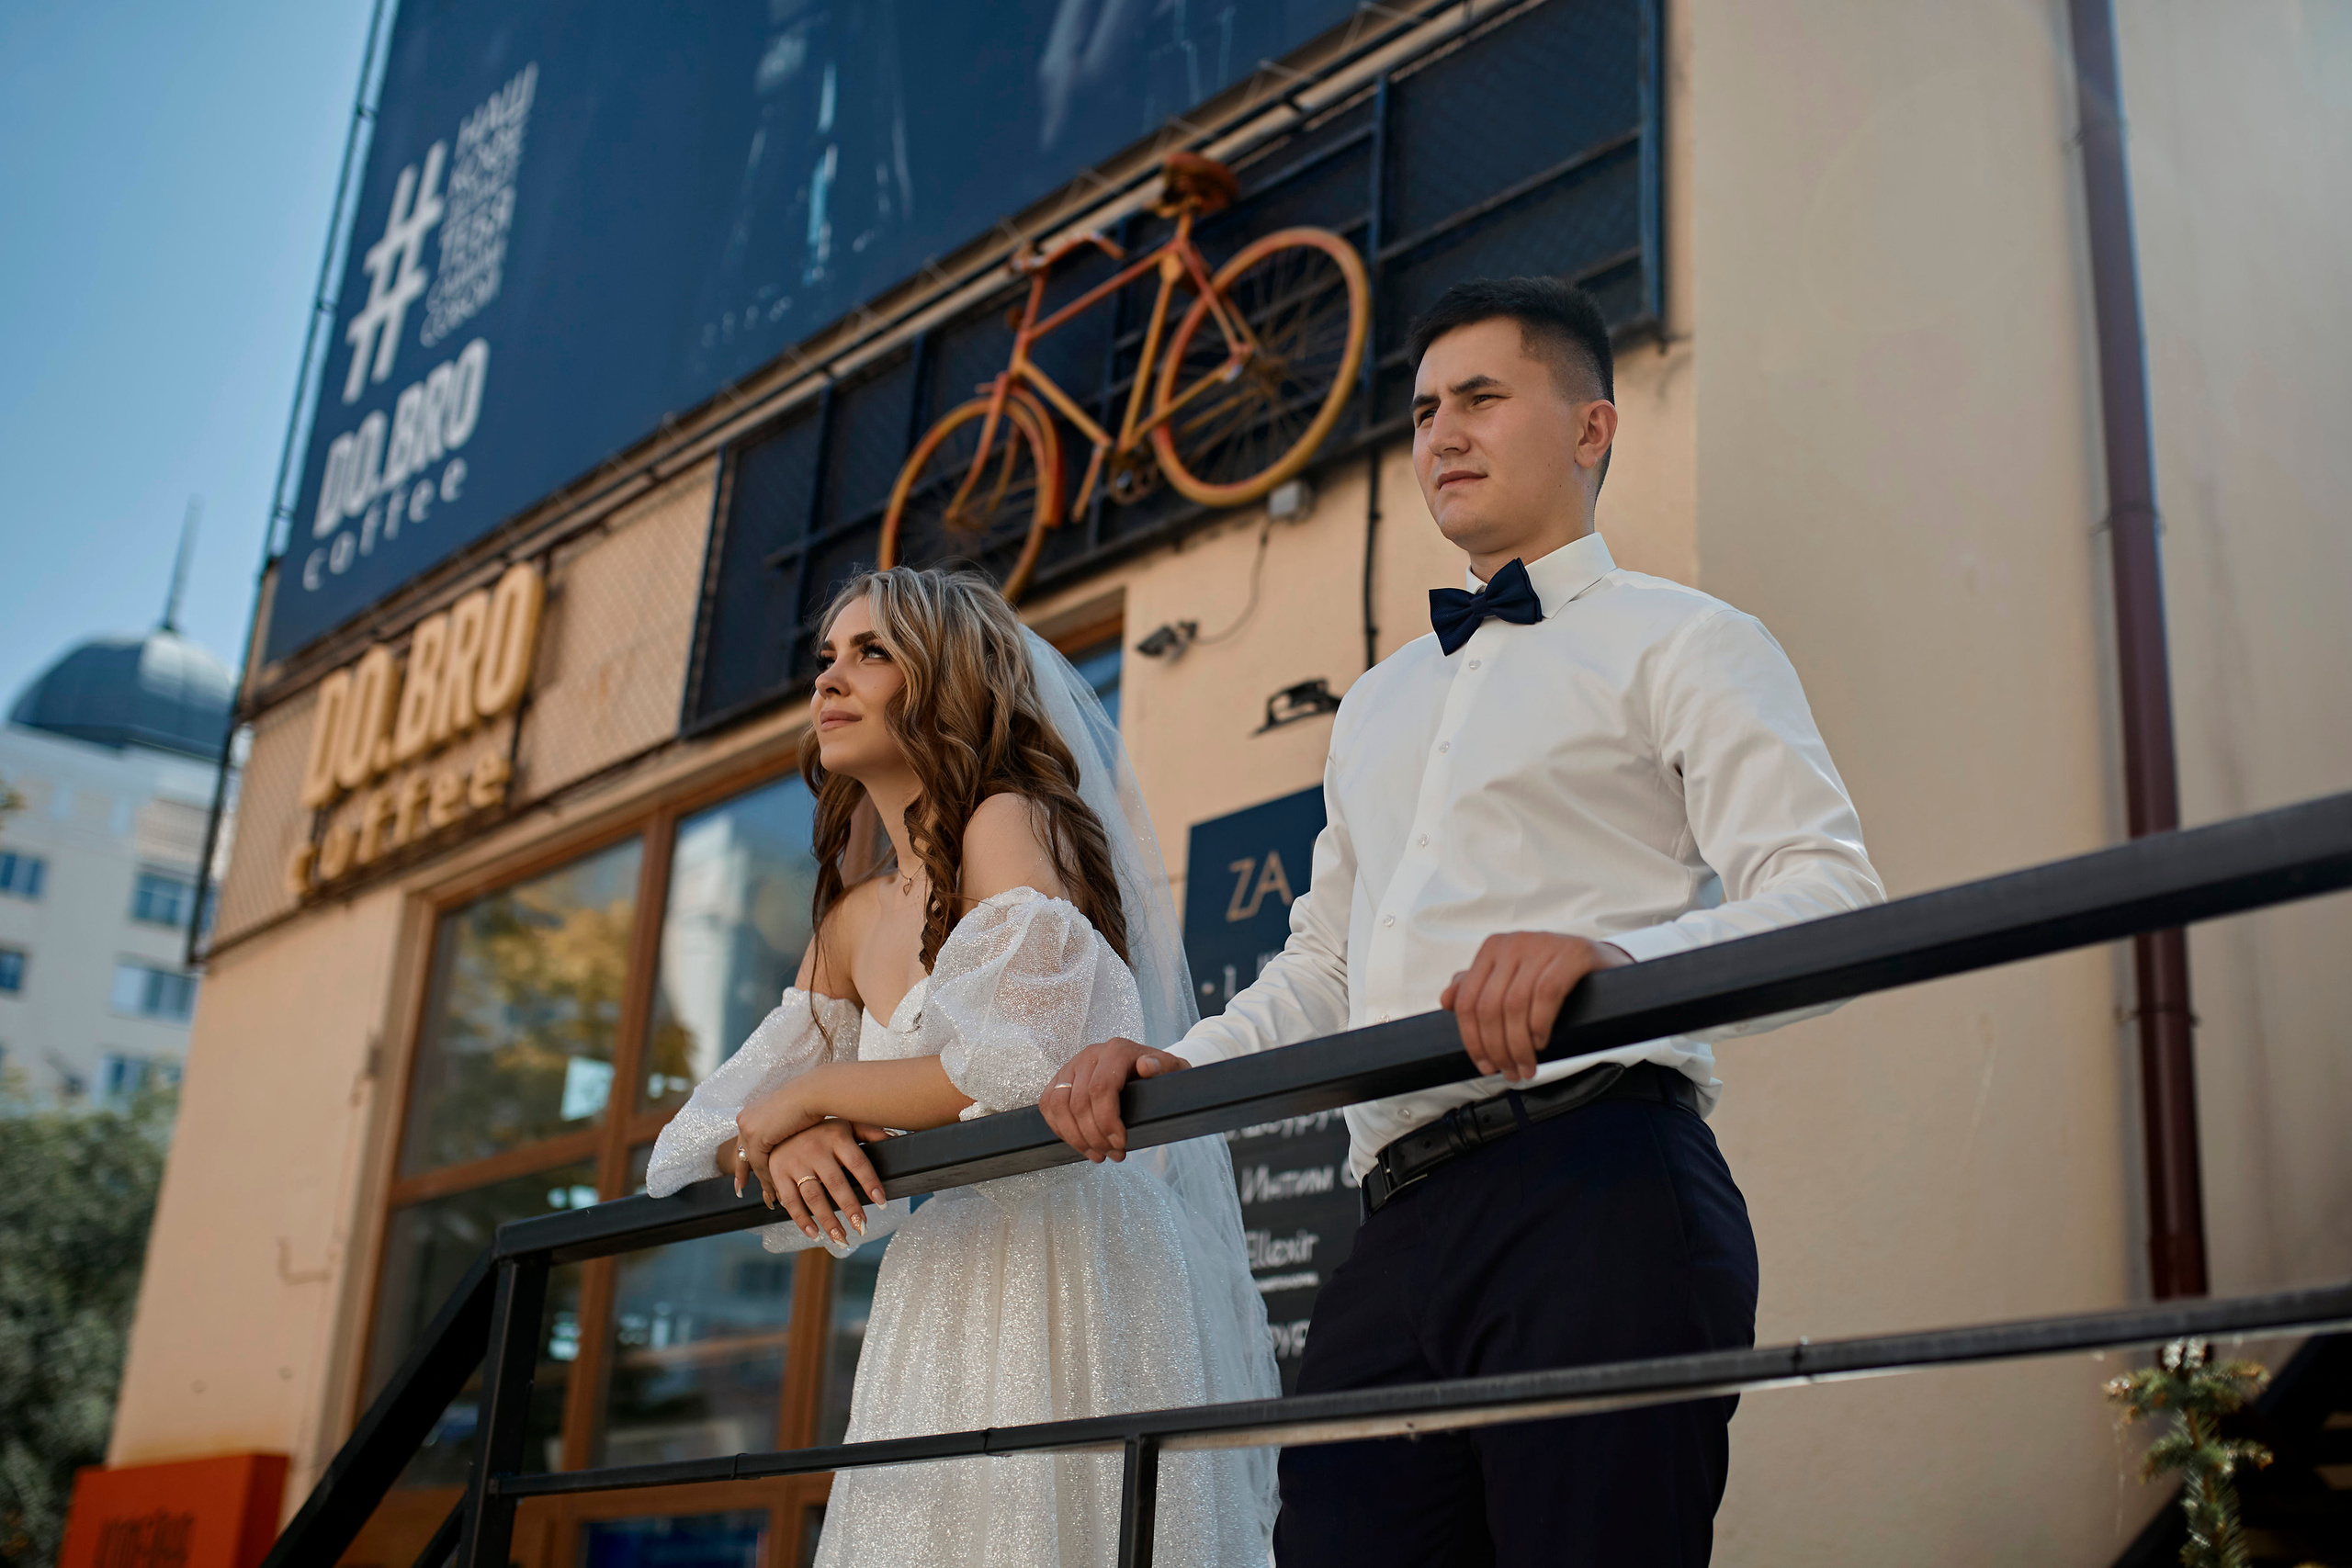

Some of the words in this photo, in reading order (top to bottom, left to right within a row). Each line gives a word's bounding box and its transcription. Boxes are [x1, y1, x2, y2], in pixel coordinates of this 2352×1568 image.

[302, 457, 468, 592] coffee
[312, 336, 489, 540] DO.BRO
[301, 561, 545, 807] DO.BRO
[286, 750, 510, 897] coffee
